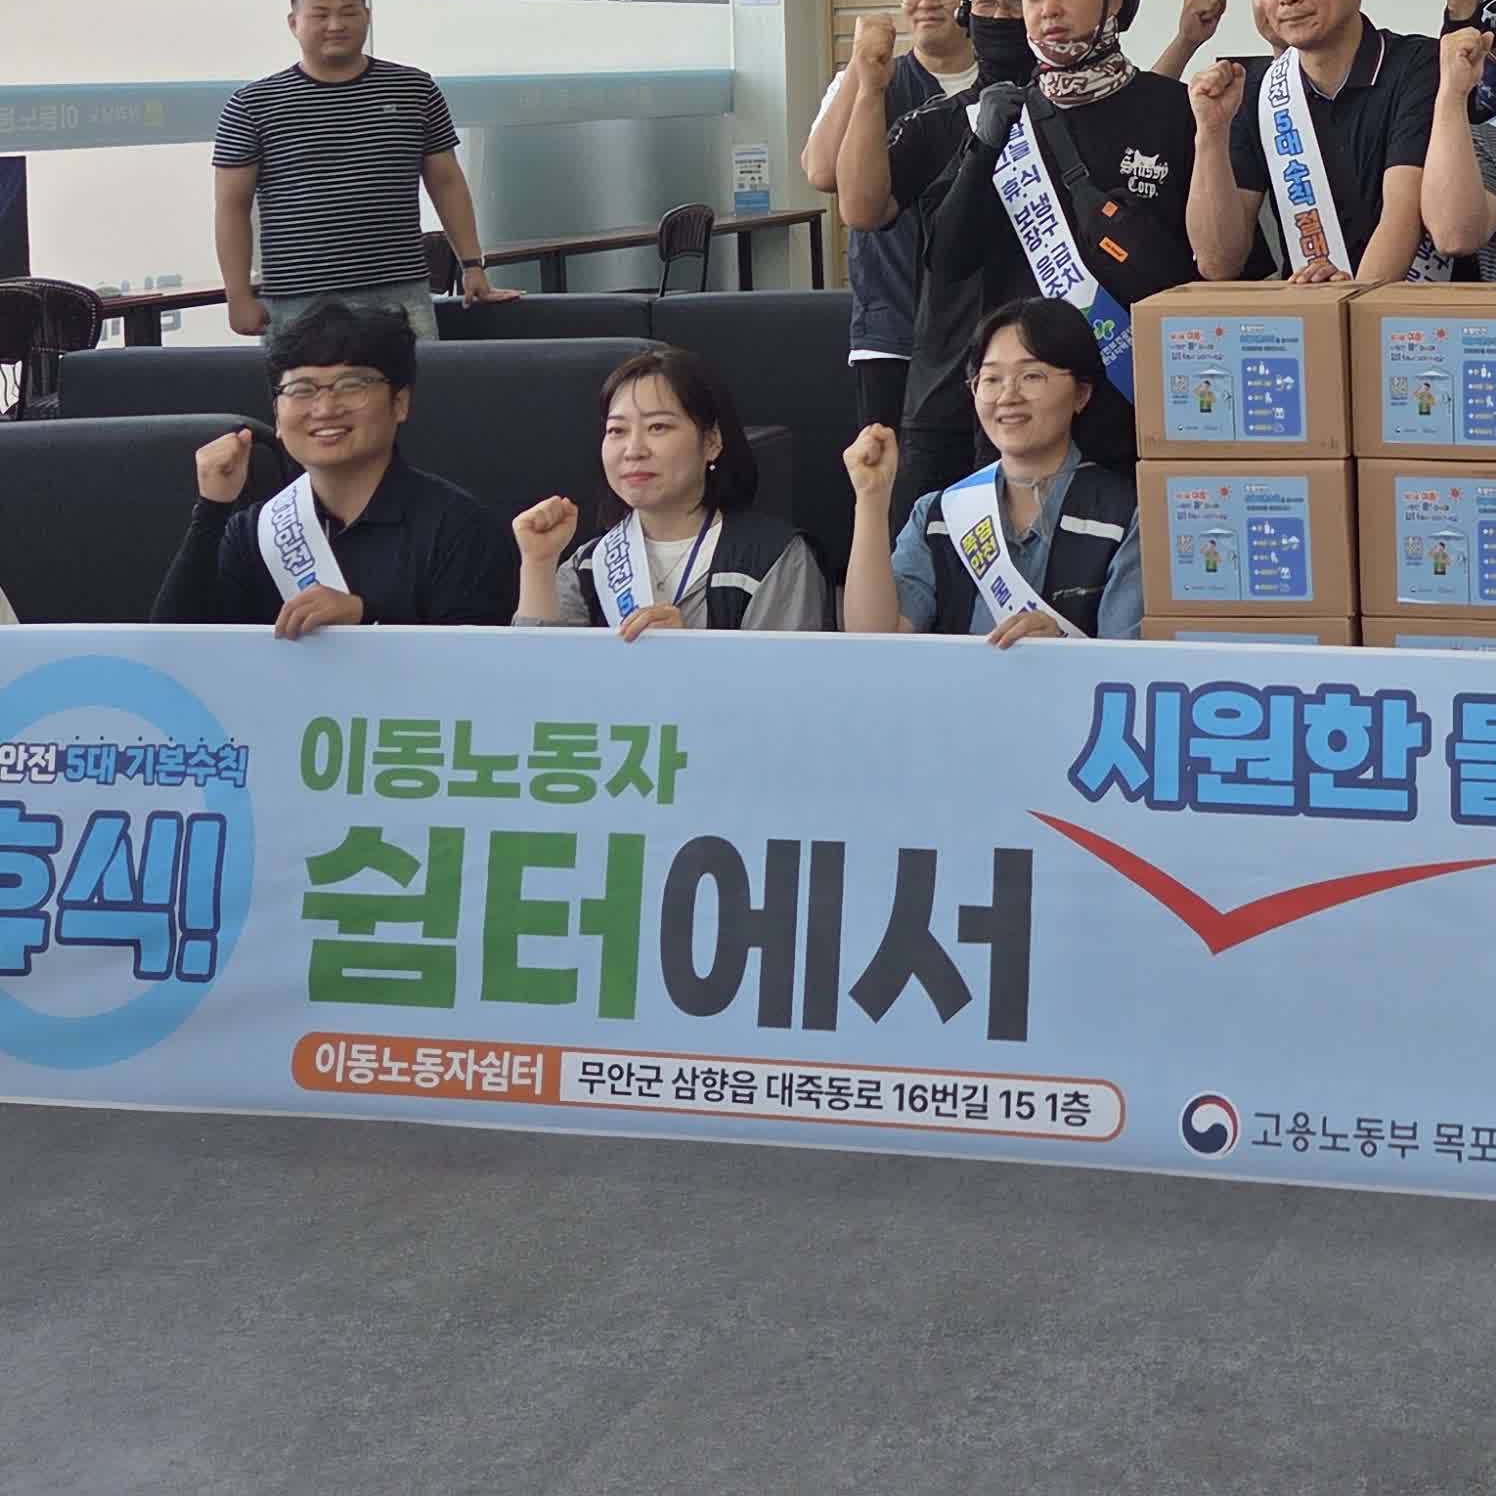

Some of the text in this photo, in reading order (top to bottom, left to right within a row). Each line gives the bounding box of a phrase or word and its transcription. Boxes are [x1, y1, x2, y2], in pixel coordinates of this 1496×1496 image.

[1273, 108, 1305, 156] 5대
[1128, 176, 1159, 198] Corp.
[1283, 159, 1317, 206] 수칙
[65, 743, 118, 785] 5대
[124, 744, 249, 788] 기본수칙
[301, 715, 688, 805] 이동노동자
[1066, 680, 1432, 825] 시원한
[301, 825, 1033, 1042] 쉼터에서
[315, 1041, 1091, 1129] 이동노동자쉼터 무안군 삼향읍 대죽동로 16번길 15 1층
[1251, 1110, 1420, 1160] 고용노동부
